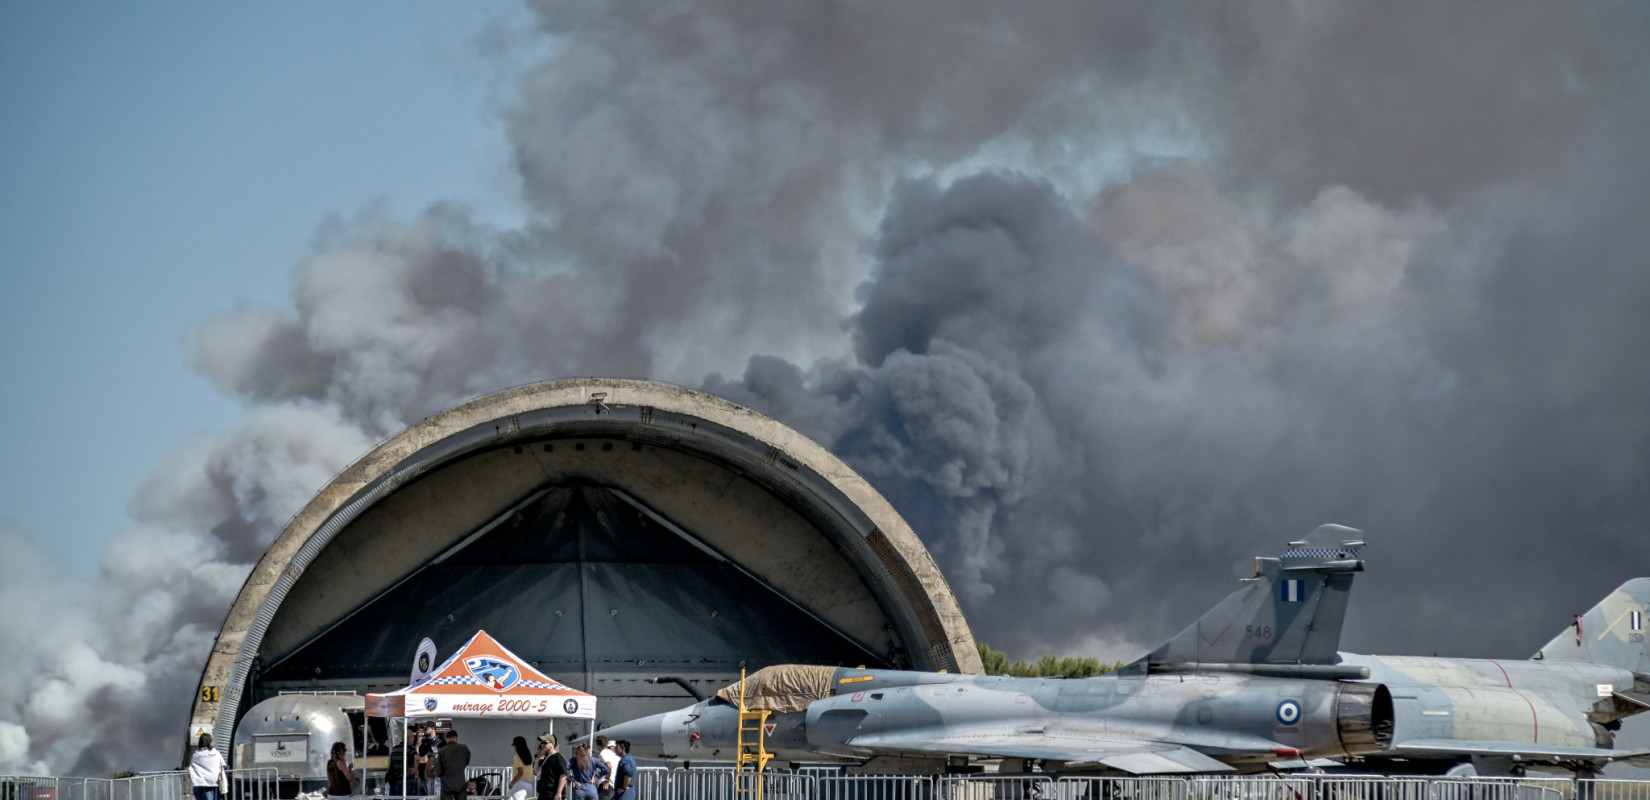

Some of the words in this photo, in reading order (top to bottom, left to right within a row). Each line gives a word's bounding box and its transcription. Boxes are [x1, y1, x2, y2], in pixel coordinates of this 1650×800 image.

[1246, 625, 1271, 640] 548
[203, 686, 219, 702] 31
[453, 701, 493, 715] mirage
[498, 699, 548, 713] 2000-5
